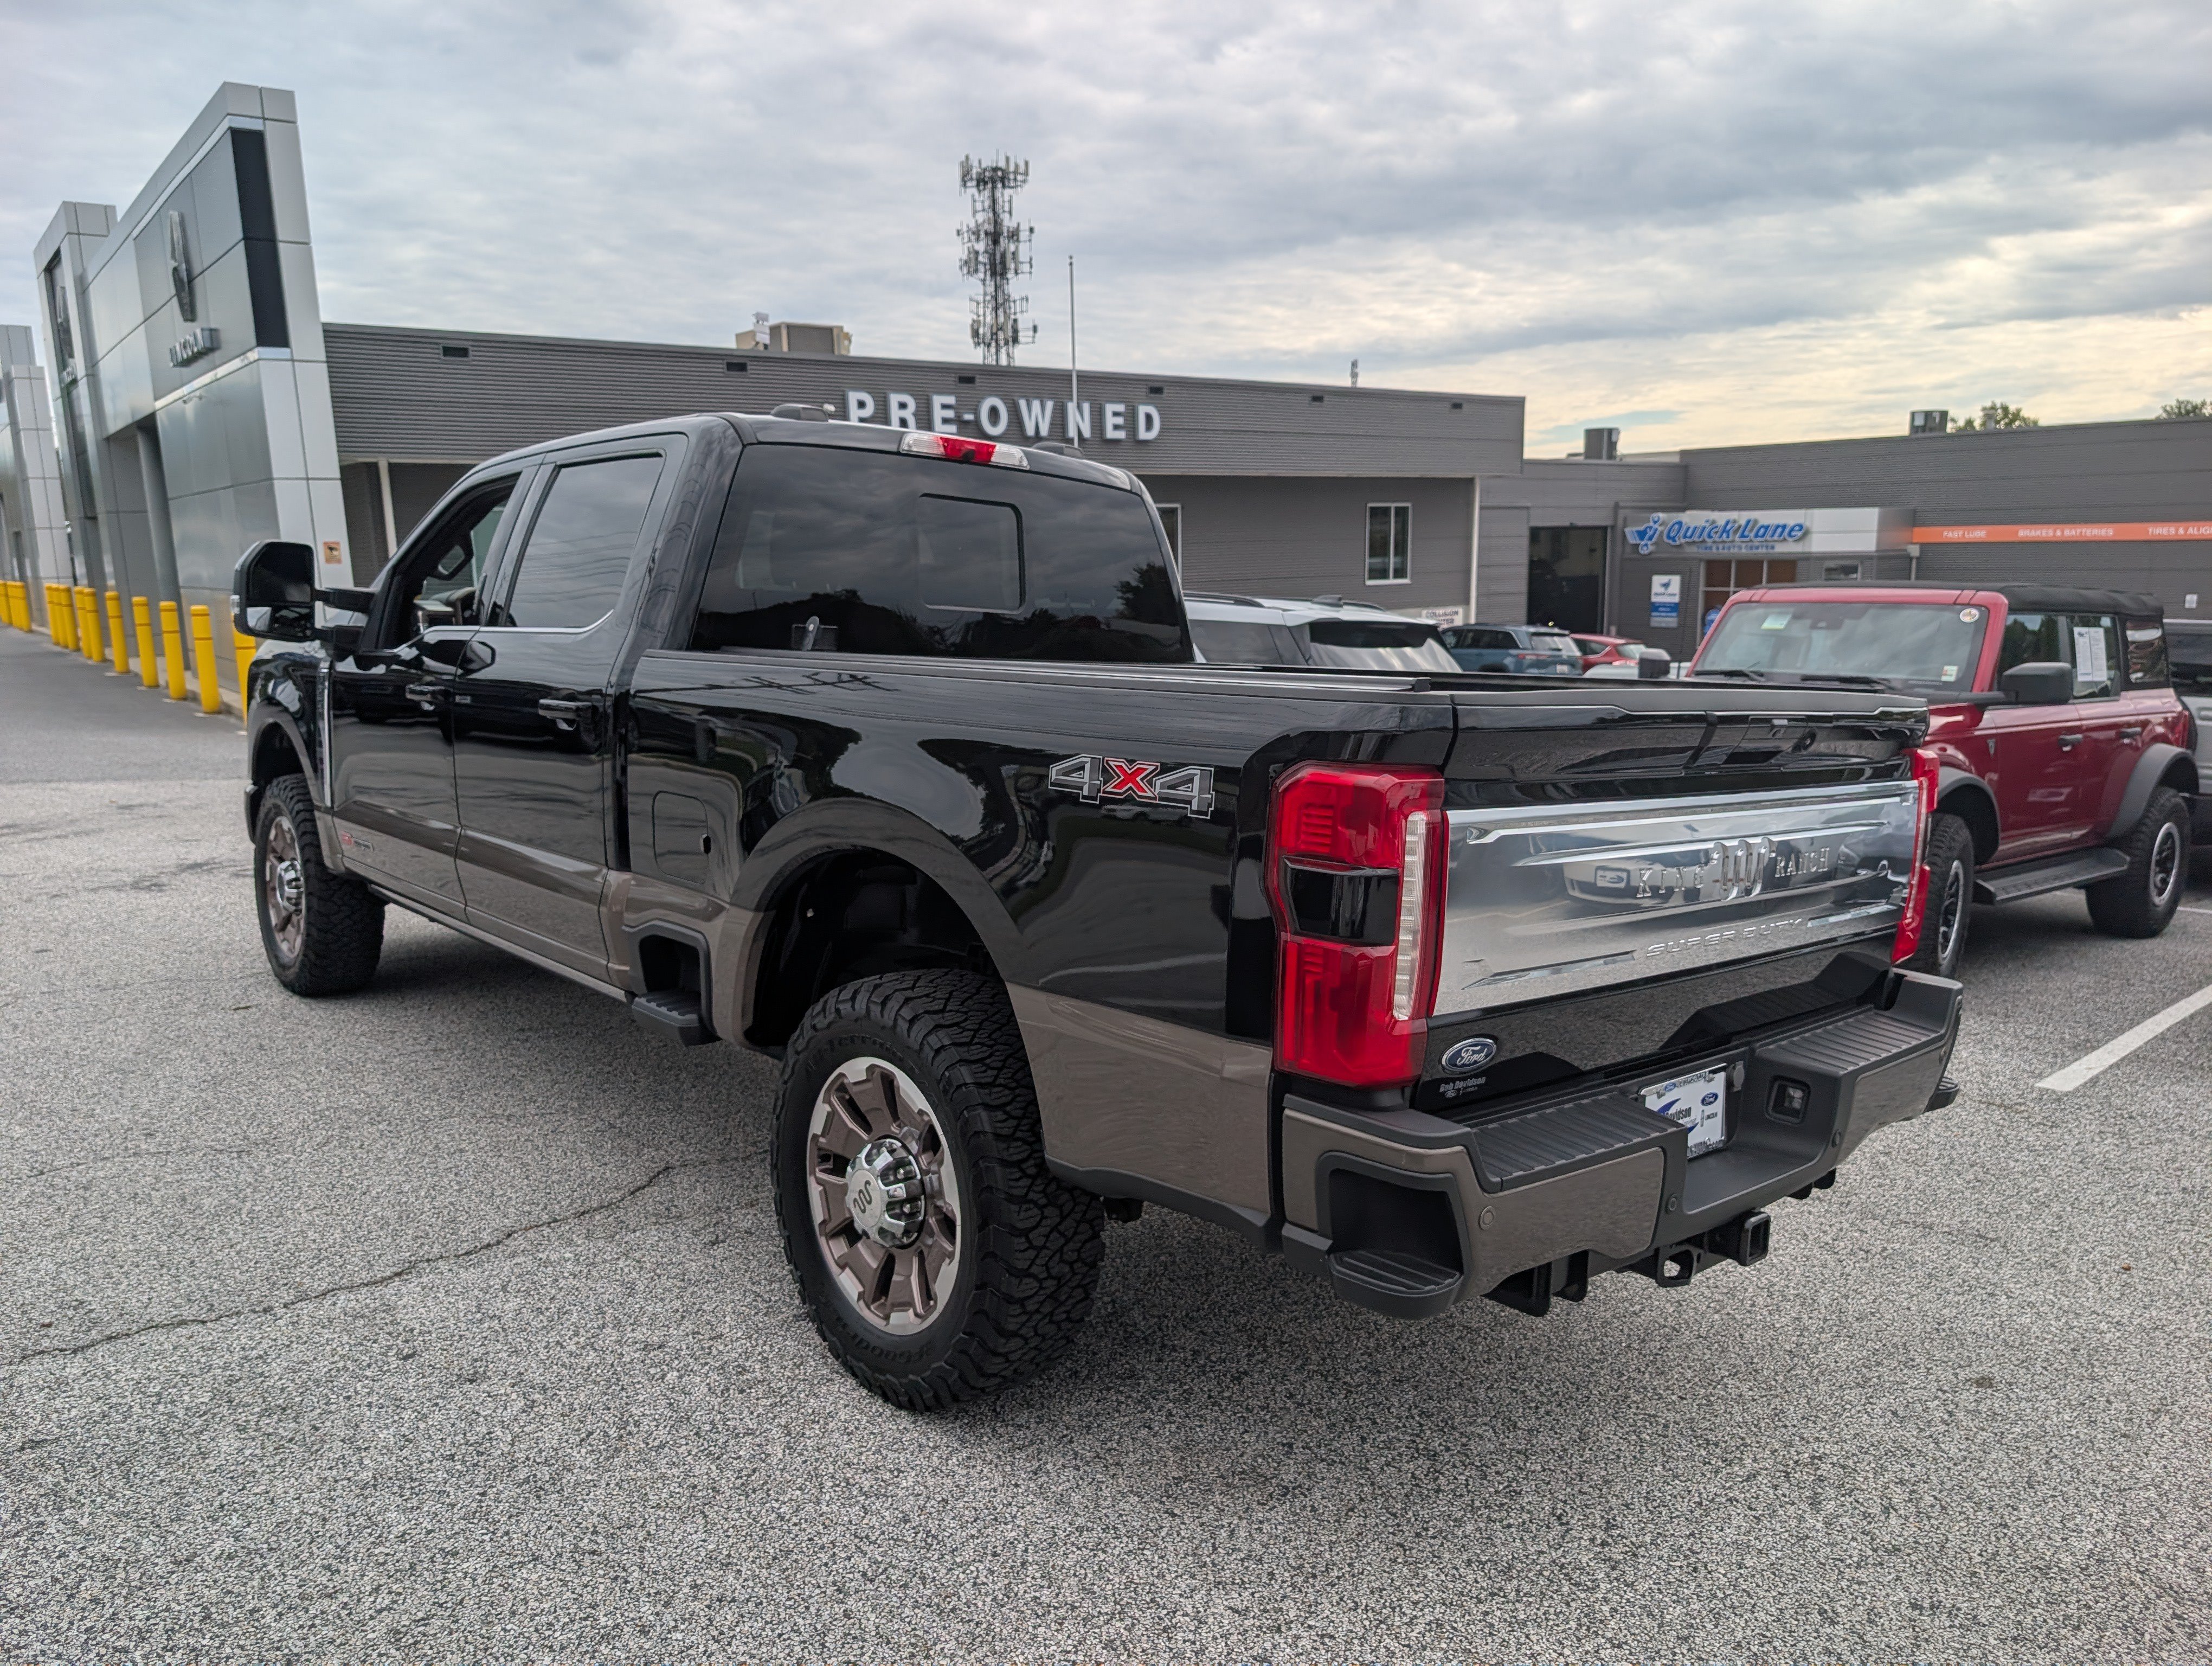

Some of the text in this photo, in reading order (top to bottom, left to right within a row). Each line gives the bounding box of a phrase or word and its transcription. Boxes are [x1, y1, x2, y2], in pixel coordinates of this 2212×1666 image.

[847, 390, 1161, 440] PRE-OWNED
[1664, 518, 1805, 544] Quick Lane
[1943, 530, 1964, 539] FAST
[1965, 529, 1987, 538] LUBE
[2018, 529, 2054, 537] BRAKES
[2055, 529, 2062, 537] &
[2063, 528, 2113, 537] BATTERIES
[2149, 527, 2175, 536] TIRES
[2177, 527, 2184, 535] &
[1636, 847, 1830, 898] KING RANCH
[1646, 918, 1803, 957] SUPER DUTY
[1456, 1046, 1488, 1066] Ford
[1439, 1077, 1486, 1092] Bob Davidson
